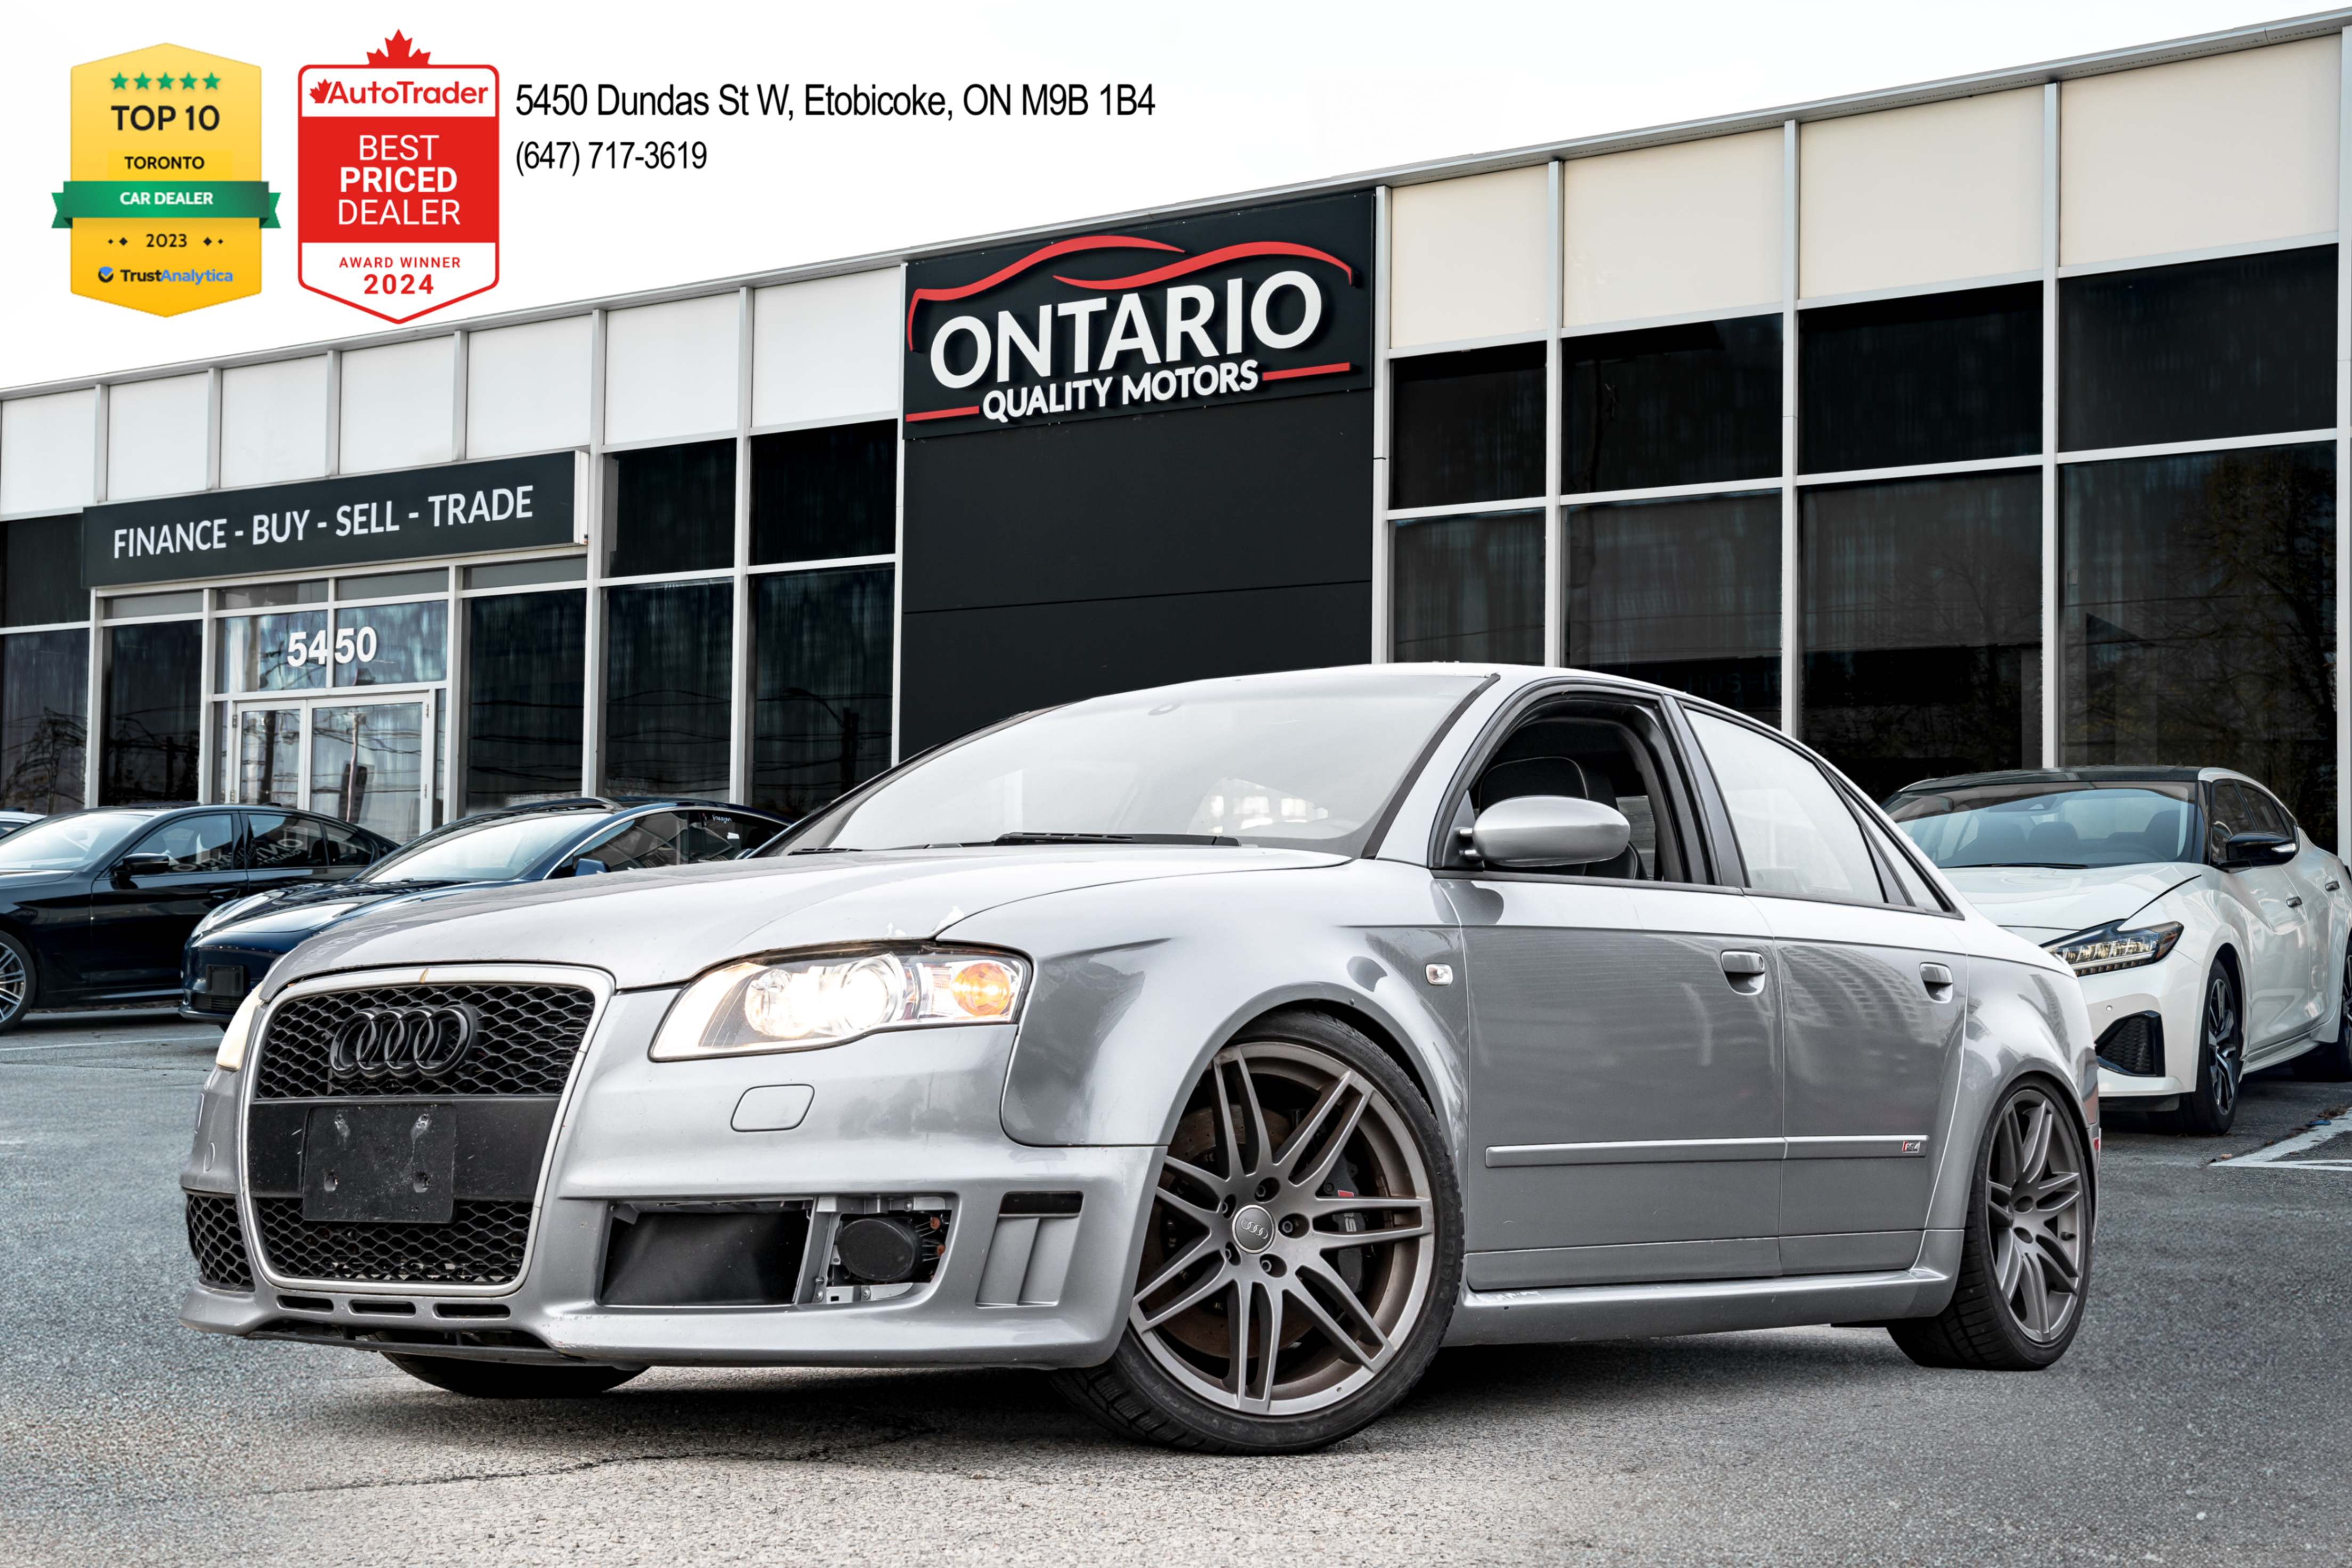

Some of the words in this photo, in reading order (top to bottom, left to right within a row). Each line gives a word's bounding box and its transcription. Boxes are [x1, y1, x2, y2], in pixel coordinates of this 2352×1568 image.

[930, 270, 1322, 389] ONTARIO
[982, 378, 1112, 423] QUALITY
[1121, 359, 1259, 406] MOTORS
[114, 518, 227, 559] FINANCE
[252, 508, 311, 546] BUY
[335, 499, 400, 537] SELL
[428, 485, 534, 528] TRADE
[286, 626, 378, 667] 5450
